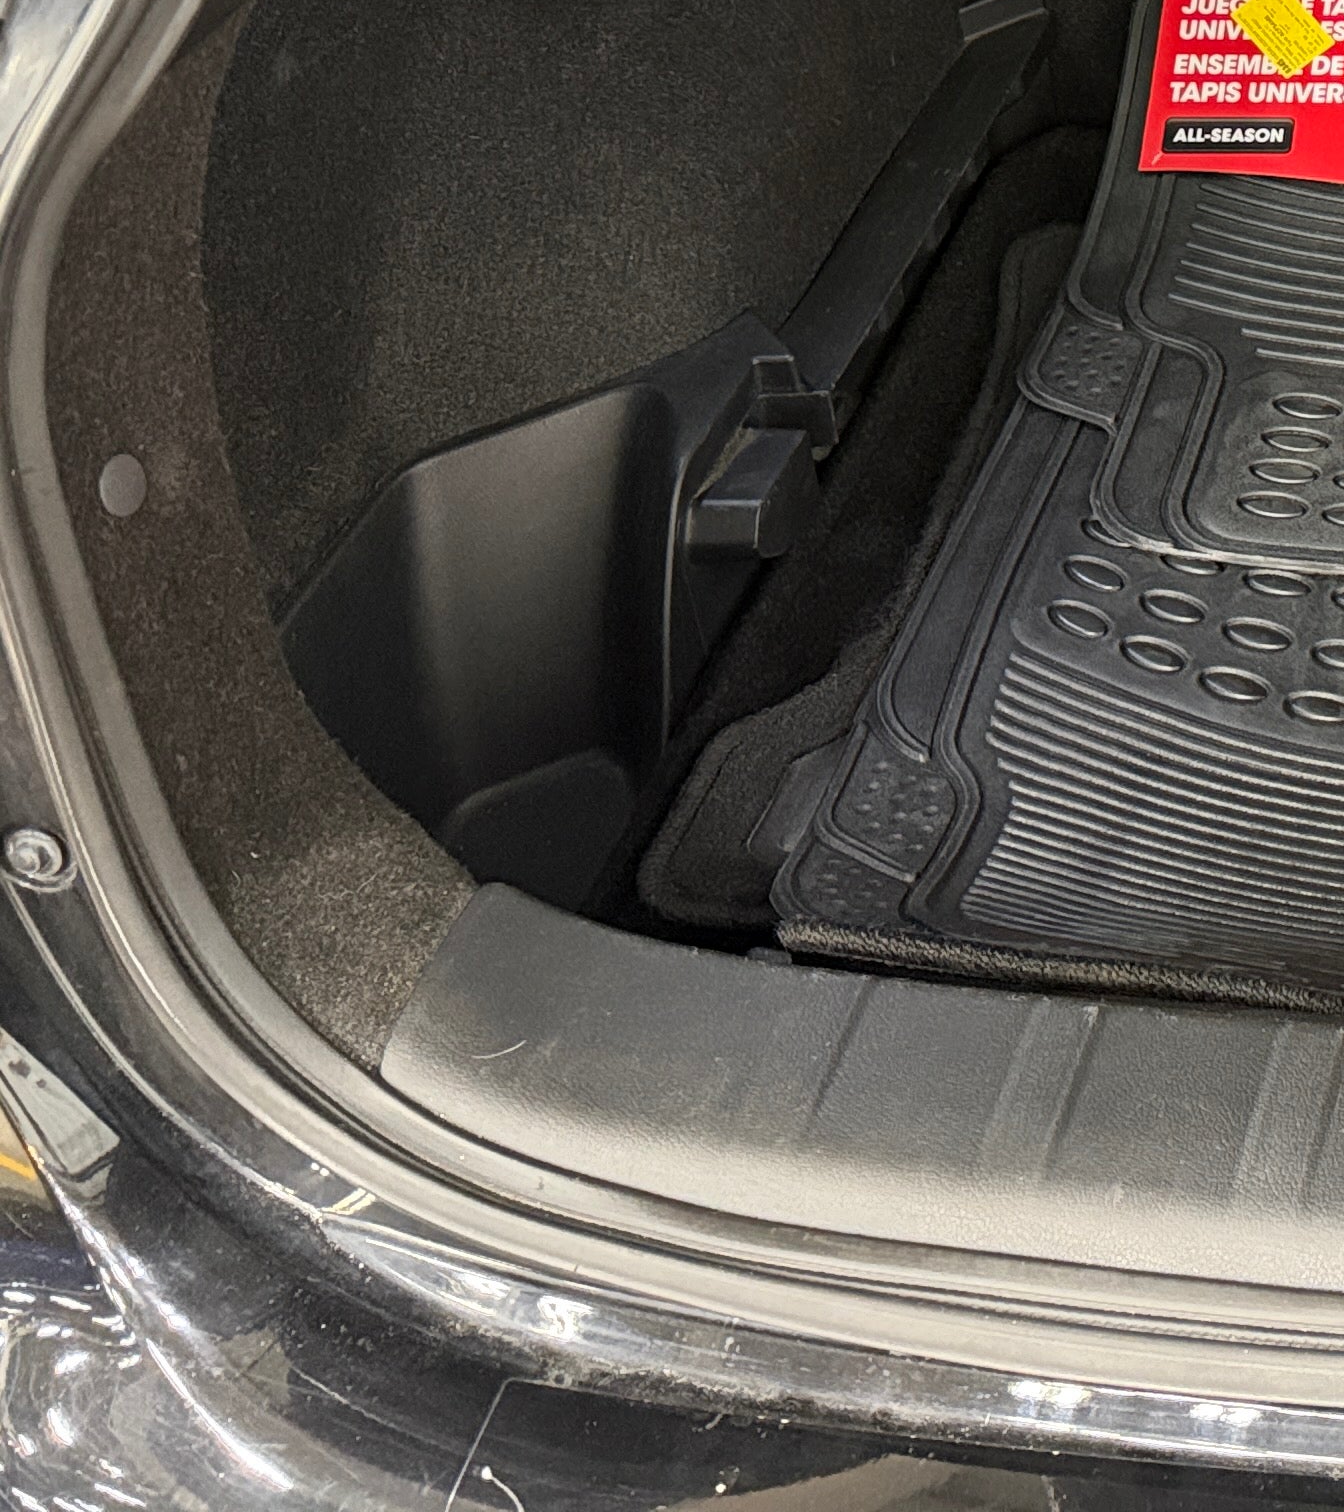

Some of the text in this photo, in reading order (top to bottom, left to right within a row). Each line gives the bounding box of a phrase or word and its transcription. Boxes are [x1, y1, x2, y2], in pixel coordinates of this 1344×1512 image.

[1173, 53, 1304, 76] ENSEMB
[1170, 82, 1242, 103] TAPIS
[1172, 127, 1285, 143] ALL-SEASON
